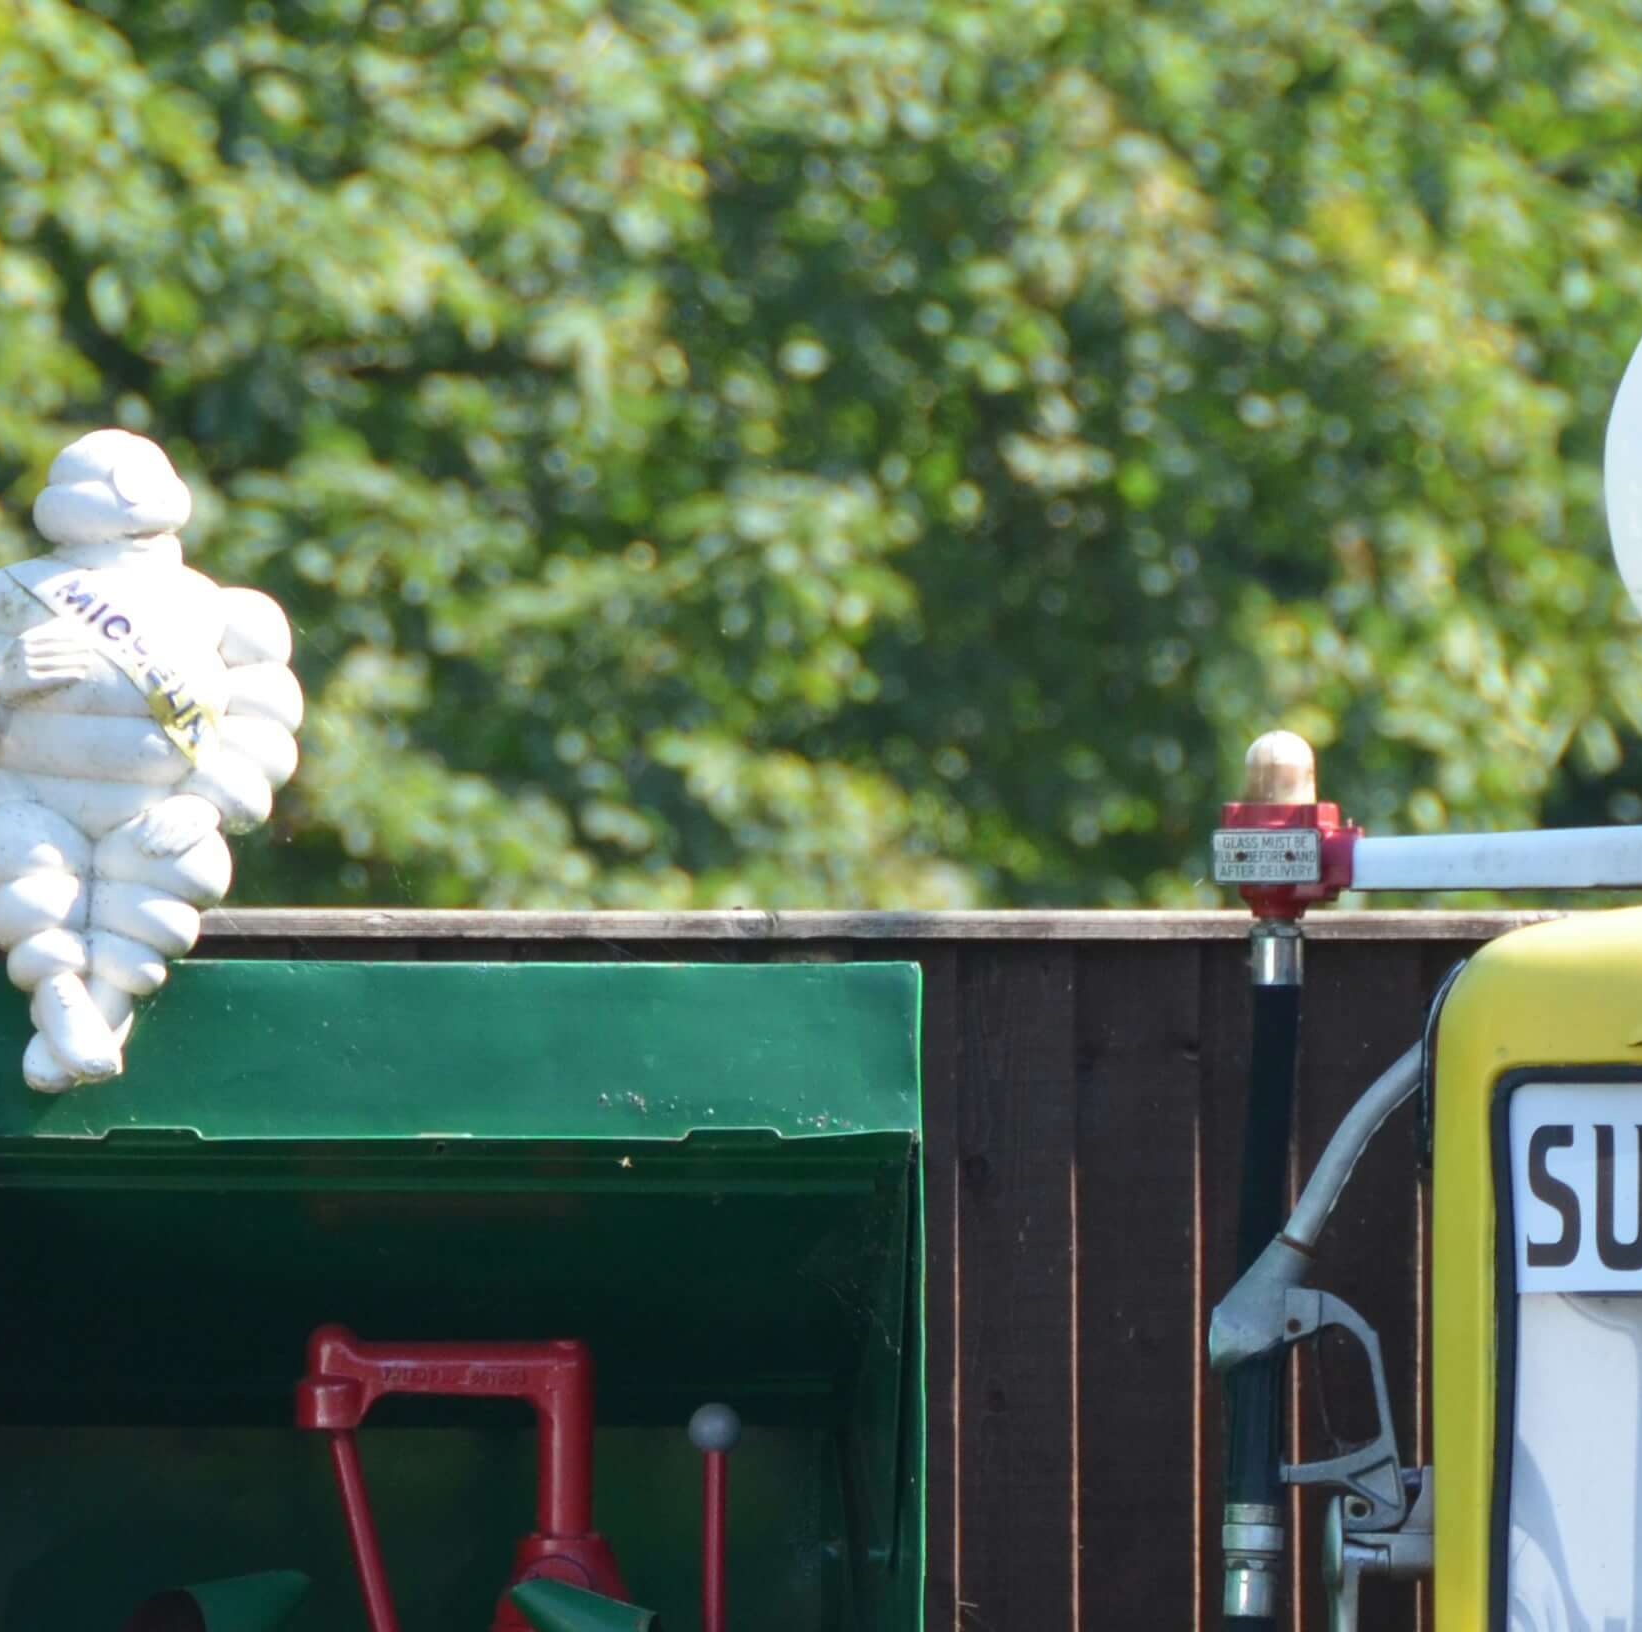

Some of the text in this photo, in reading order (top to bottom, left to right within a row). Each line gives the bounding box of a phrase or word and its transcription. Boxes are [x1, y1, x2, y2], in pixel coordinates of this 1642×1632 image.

[53, 578, 206, 748] MICELIN
[1222, 836, 1306, 849] GLASS MUST BE
[1247, 850, 1285, 863] BEFORE
[1220, 864, 1312, 878] AFTER DELIVERY
